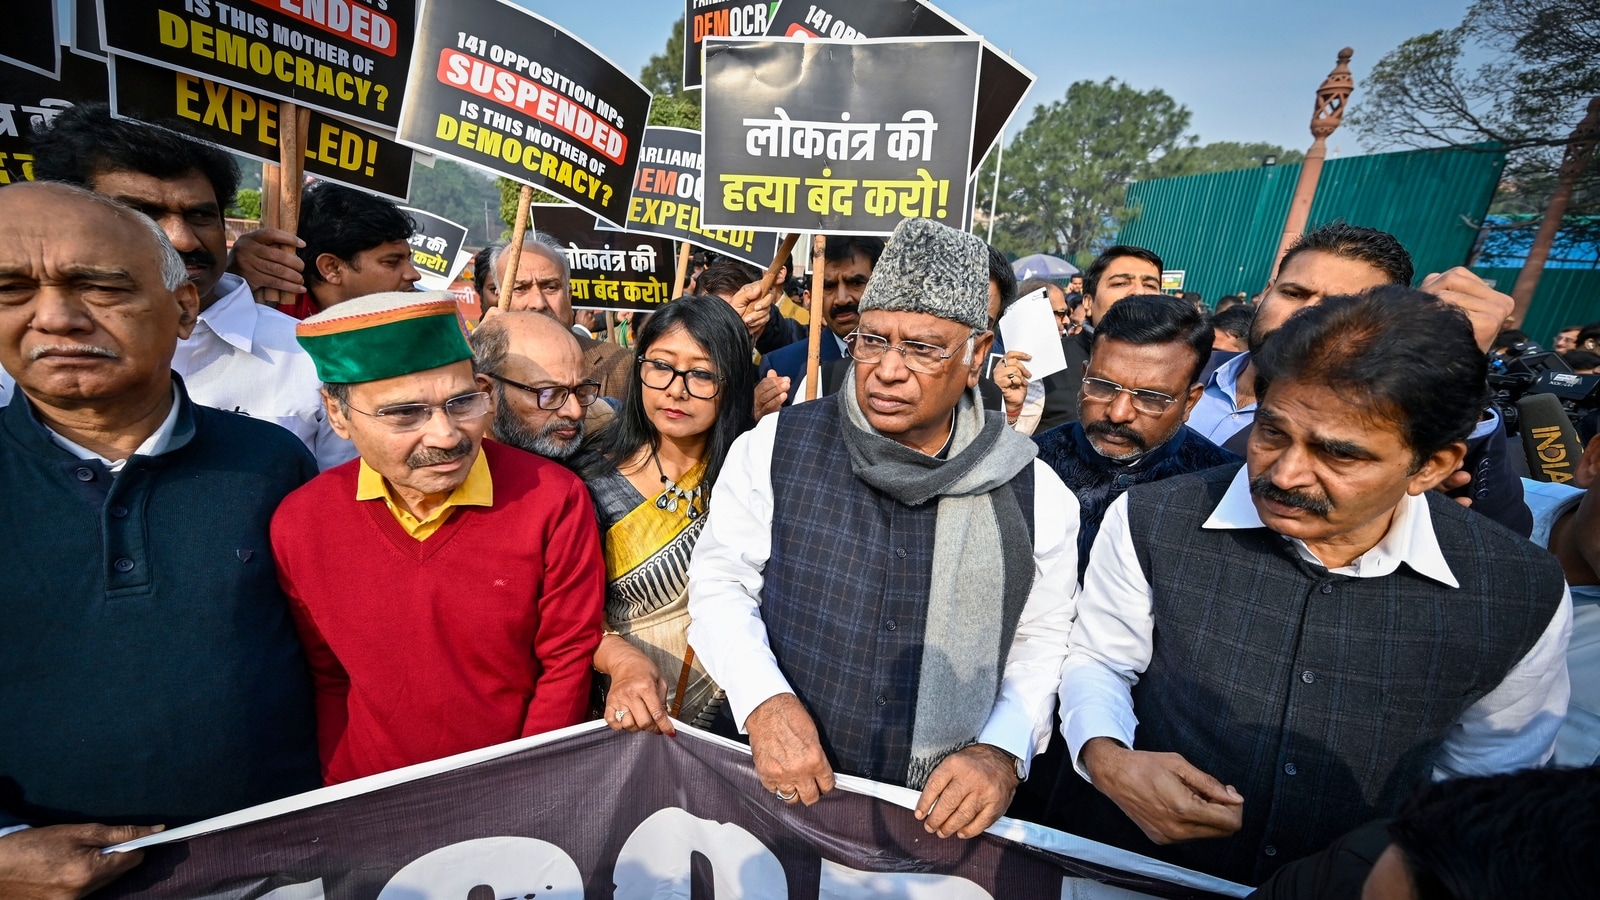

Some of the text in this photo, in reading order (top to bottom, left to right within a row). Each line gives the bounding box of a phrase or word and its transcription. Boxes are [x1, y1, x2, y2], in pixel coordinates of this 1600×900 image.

[216, 3, 269, 39] THIS
[273, 22, 349, 69] MOTHER
[352, 54, 374, 76] OF
[693, 2, 778, 43] DEMOCR
[804, 4, 833, 34] 141
[158, 8, 389, 112] DEMOCRACY?
[457, 31, 487, 58] 141
[489, 44, 596, 108] OPPOSITION
[176, 71, 378, 177] EXPEED!
[446, 54, 623, 159] SUSPENDED
[742, 107, 939, 161] लोकतंत्र की
[435, 113, 613, 208] DEMOCRACY?
[459, 100, 606, 177] IS THIS MOTHER OF
[719, 168, 950, 219] हत्या बंद करो!
[413, 249, 448, 273] करो!
[426, 236, 448, 255] की
[628, 244, 657, 273] की
[591, 274, 620, 302] बंद
[621, 275, 669, 304] करो!
[1531, 426, 1574, 483] INDIA
